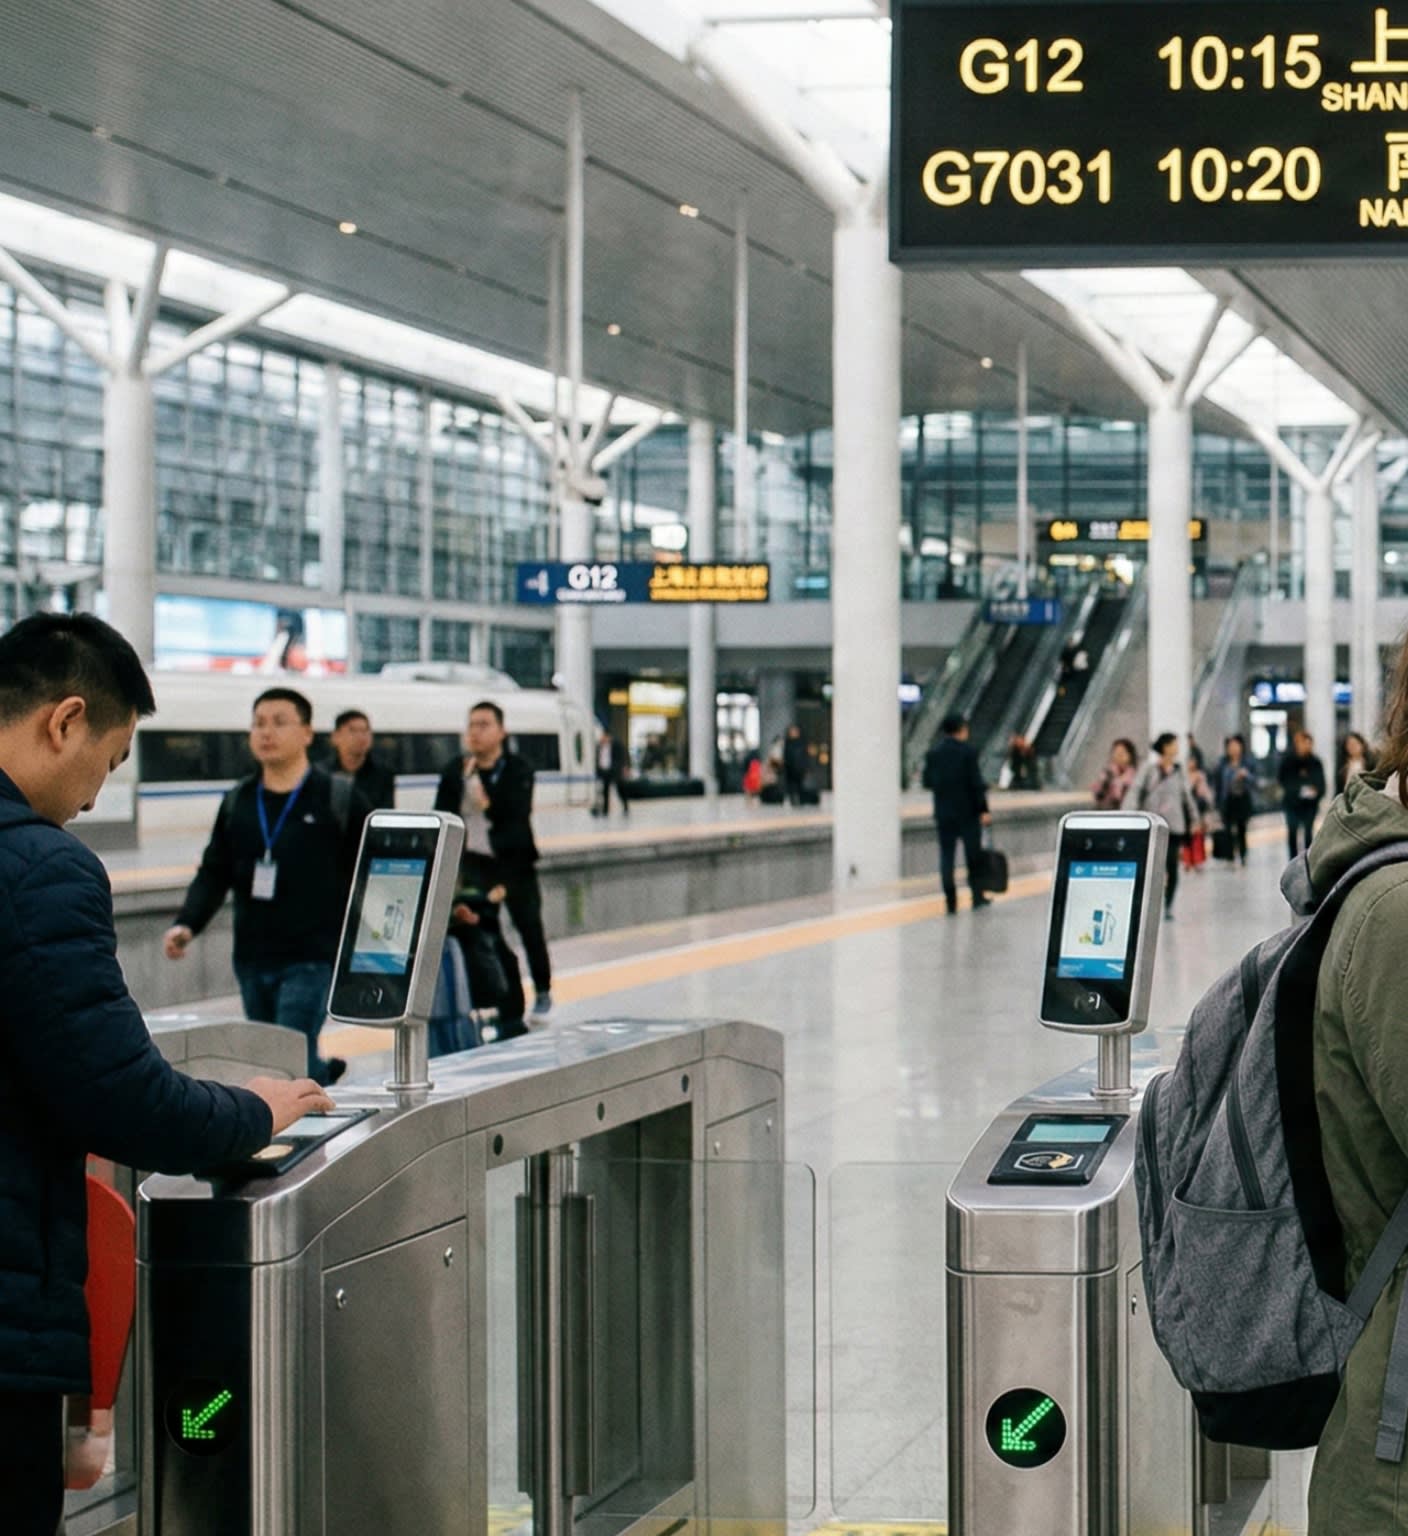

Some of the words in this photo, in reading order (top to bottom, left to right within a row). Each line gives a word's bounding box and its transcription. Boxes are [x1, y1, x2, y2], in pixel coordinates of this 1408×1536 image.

[960, 39, 1083, 94] G12
[1159, 35, 1322, 90] 10:15
[923, 150, 1110, 206] G7031
[1158, 147, 1321, 202] 10:20
